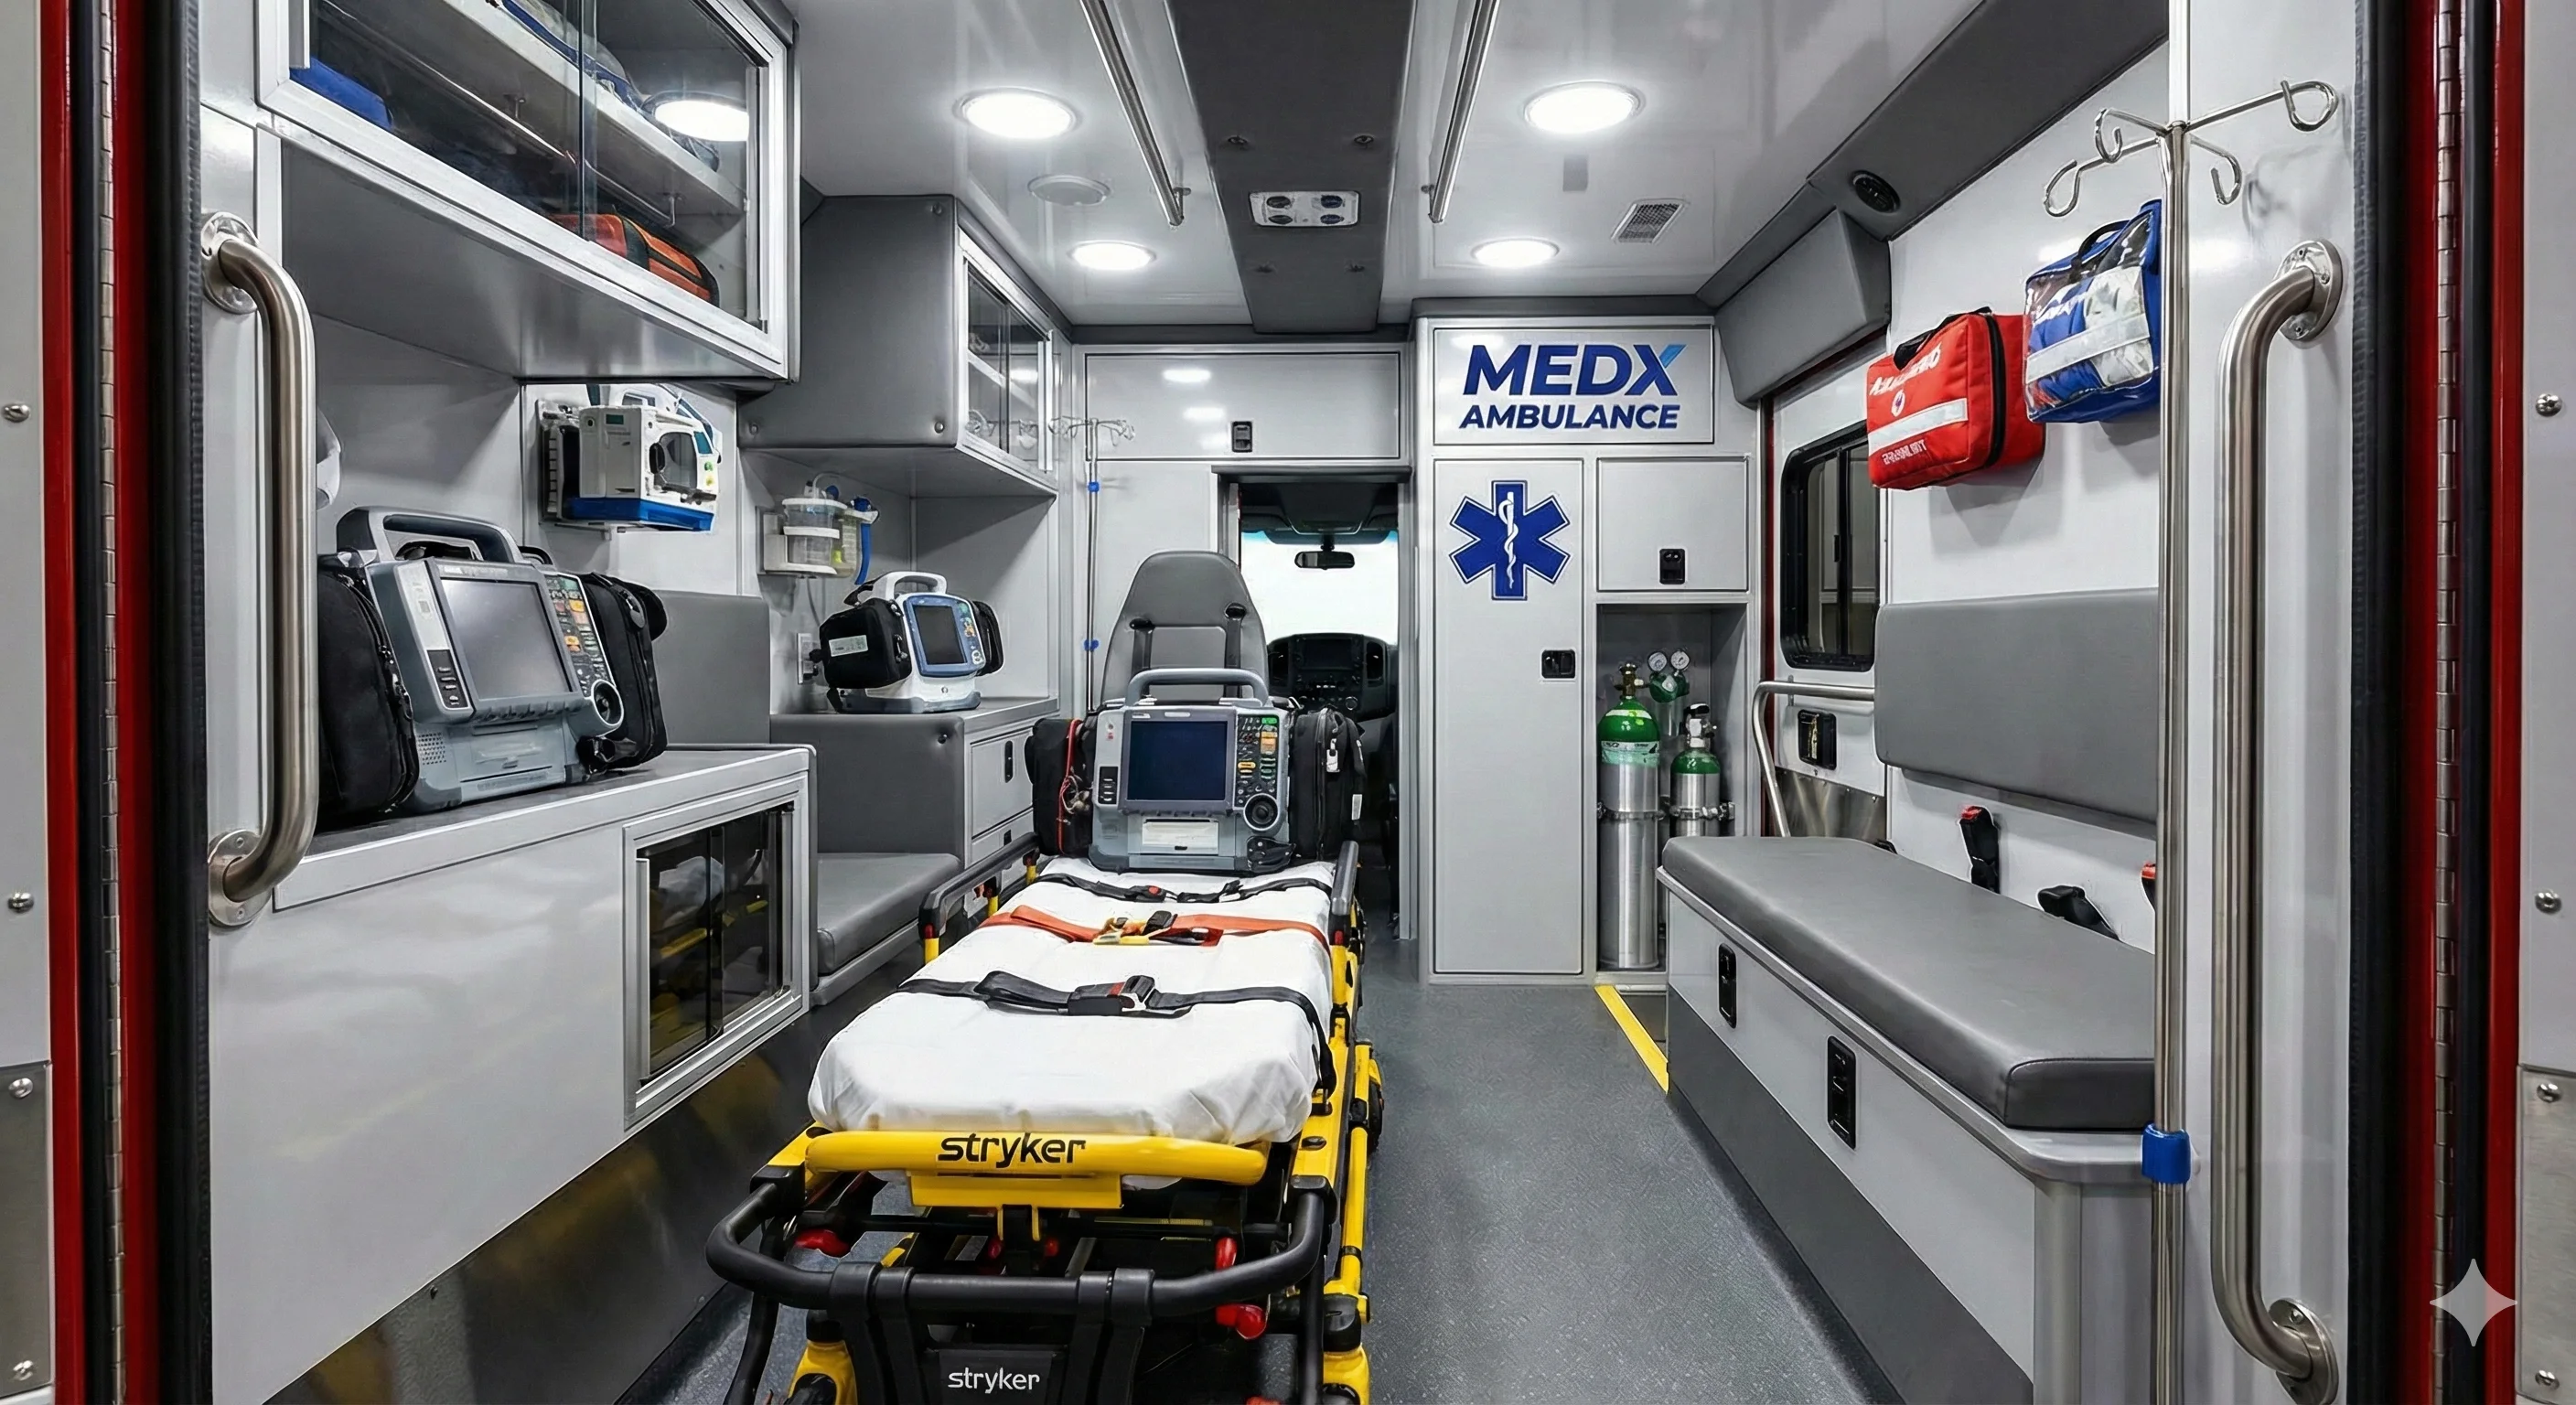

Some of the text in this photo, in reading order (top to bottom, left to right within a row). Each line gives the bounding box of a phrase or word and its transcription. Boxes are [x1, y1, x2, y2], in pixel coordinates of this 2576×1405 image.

[1463, 344, 1687, 396] MEDX
[1459, 404, 1680, 429] AMBULANCE
[938, 1132, 1087, 1169] stryker
[948, 1367, 1040, 1394] stryker
